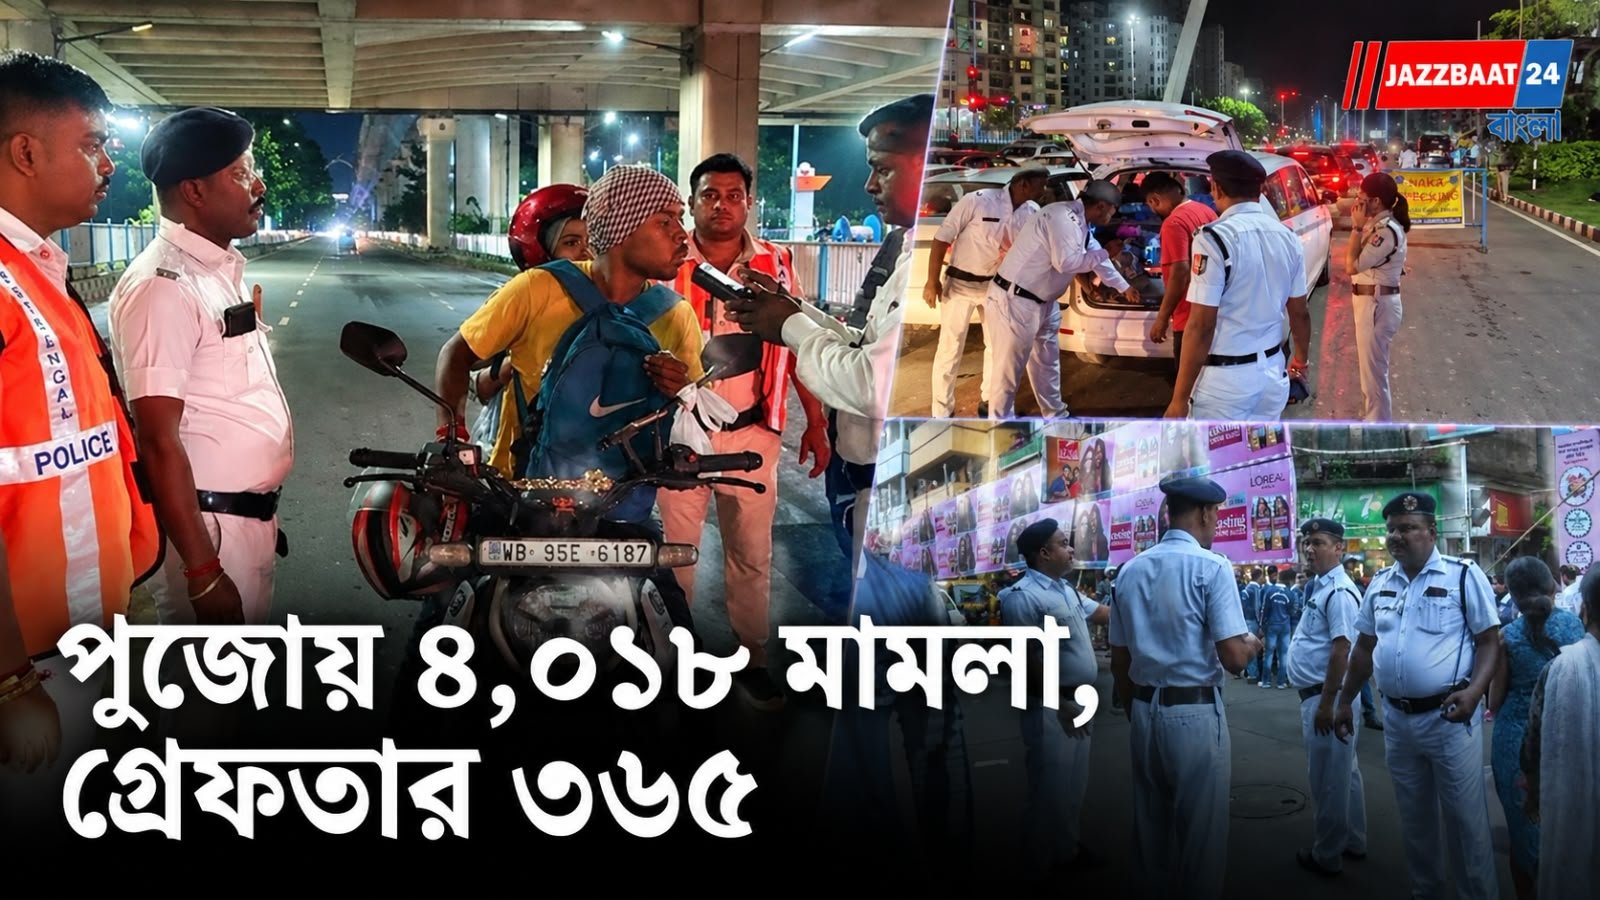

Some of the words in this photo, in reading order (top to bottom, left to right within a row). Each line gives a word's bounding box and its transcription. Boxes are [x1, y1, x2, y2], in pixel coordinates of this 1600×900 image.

[34, 430, 114, 475] POLICE
[502, 543, 527, 561] WB
[544, 544, 581, 562] 95E
[597, 544, 648, 562] 6187
